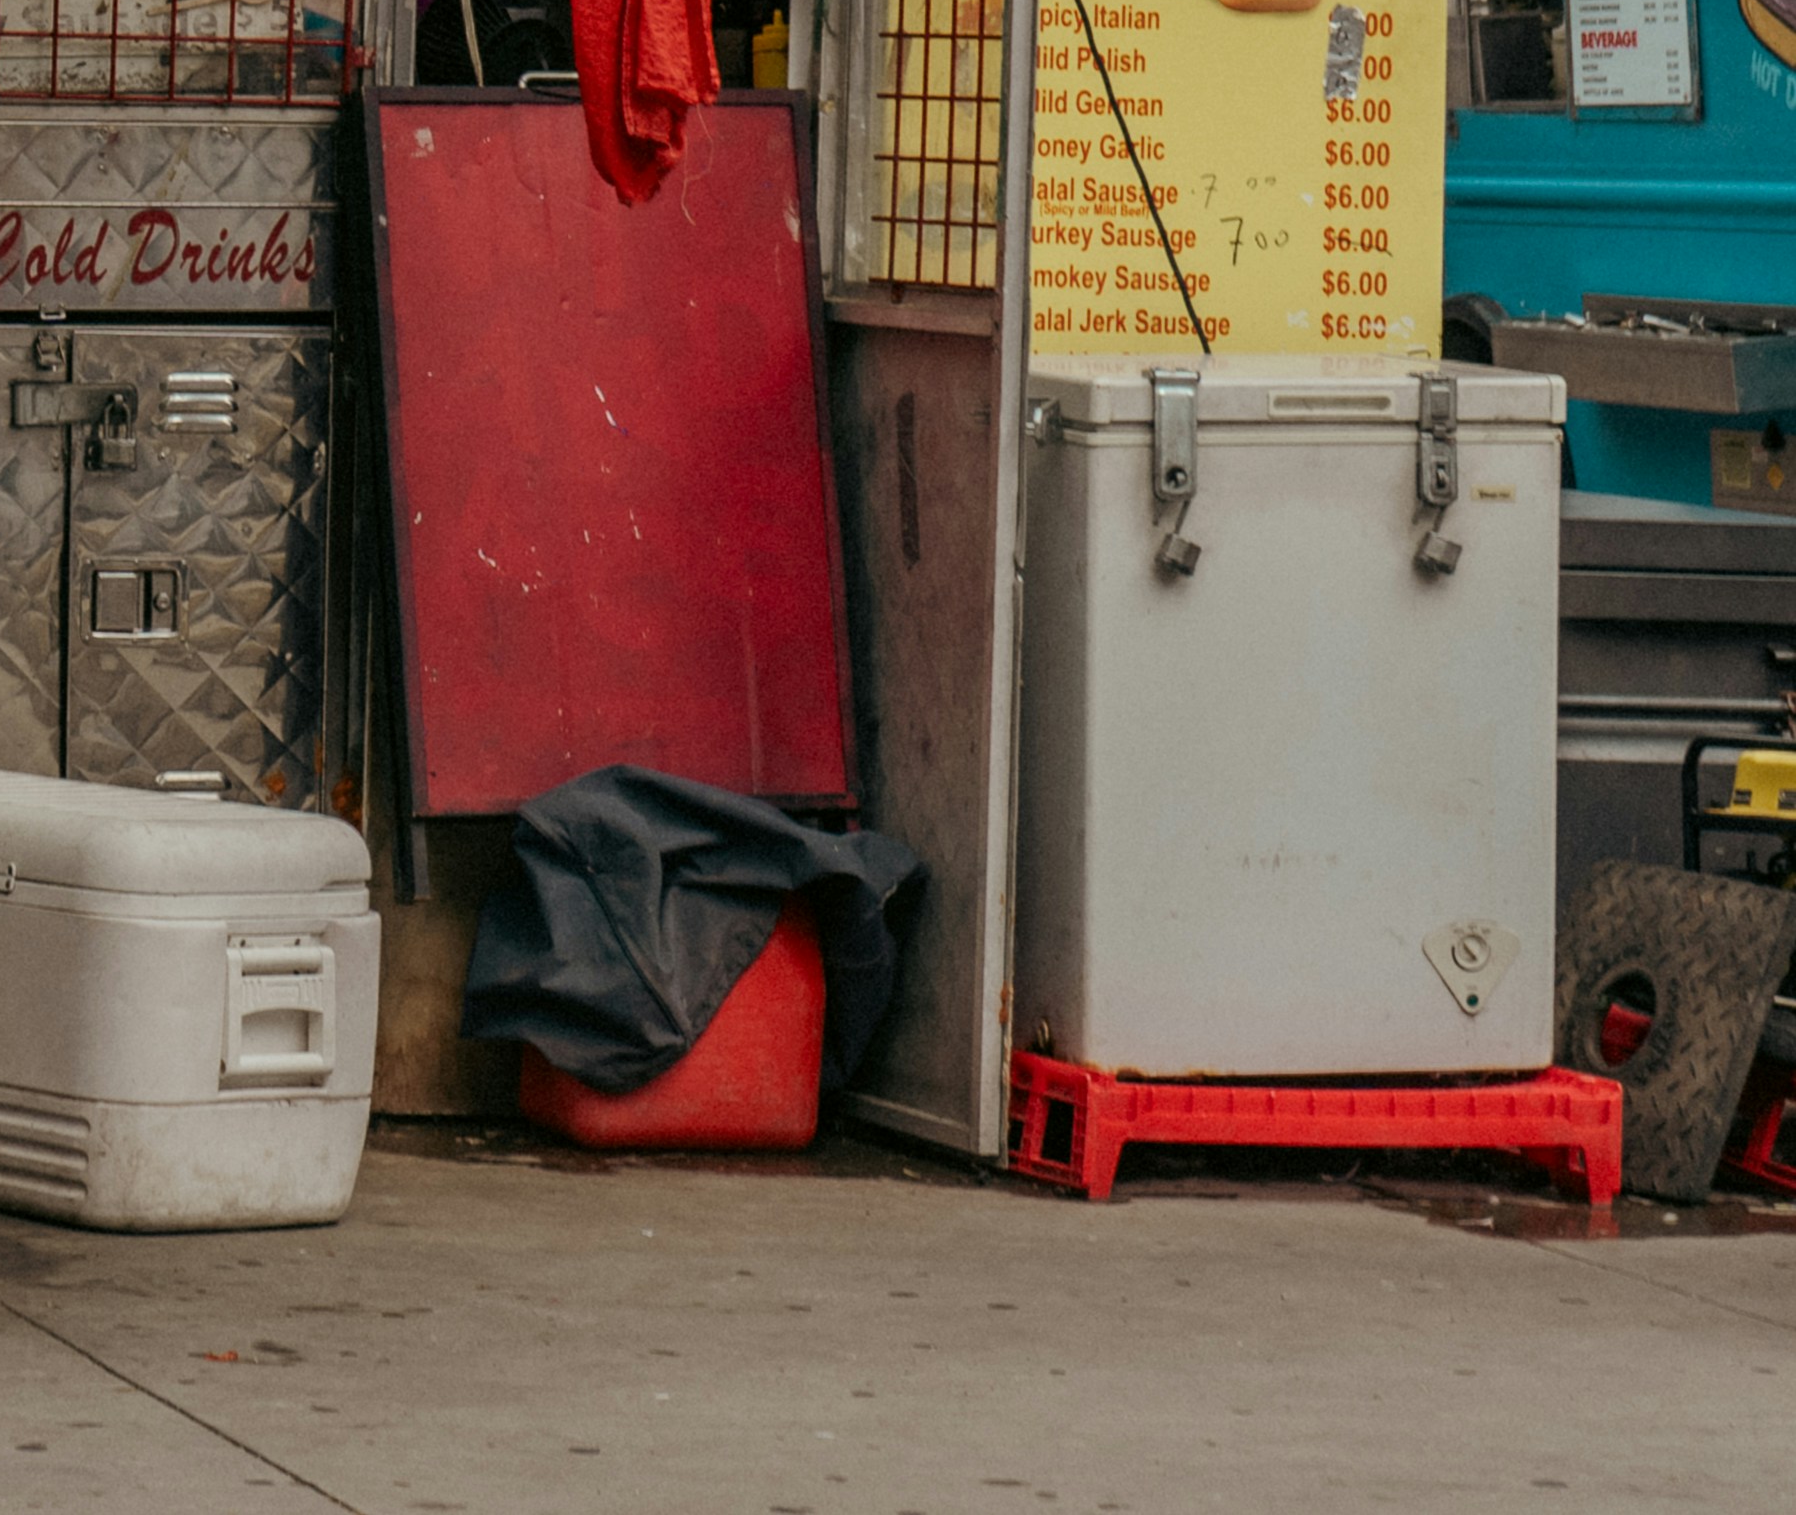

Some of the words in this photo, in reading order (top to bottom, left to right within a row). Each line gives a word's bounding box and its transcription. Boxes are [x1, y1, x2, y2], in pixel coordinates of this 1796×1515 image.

[1093, 5, 1160, 29] Italian
[1581, 30, 1638, 49] BEVERAGE
[1326, 97, 1391, 123] $6.00
[1325, 140, 1390, 166] $6.00
[1324, 183, 1389, 210] $6.00
[1040, 204, 1074, 217] (Spicy
[1078, 206, 1089, 215] or
[1093, 204, 1116, 216] Mild
[1121, 205, 1150, 218] Beef)
[127, 208, 317, 287] Drinks
[1323, 227, 1388, 253] $6.00
[1322, 271, 1387, 297] $6.00
[1079, 309, 1127, 333] Jerk
[1321, 313, 1386, 341] $6.00
